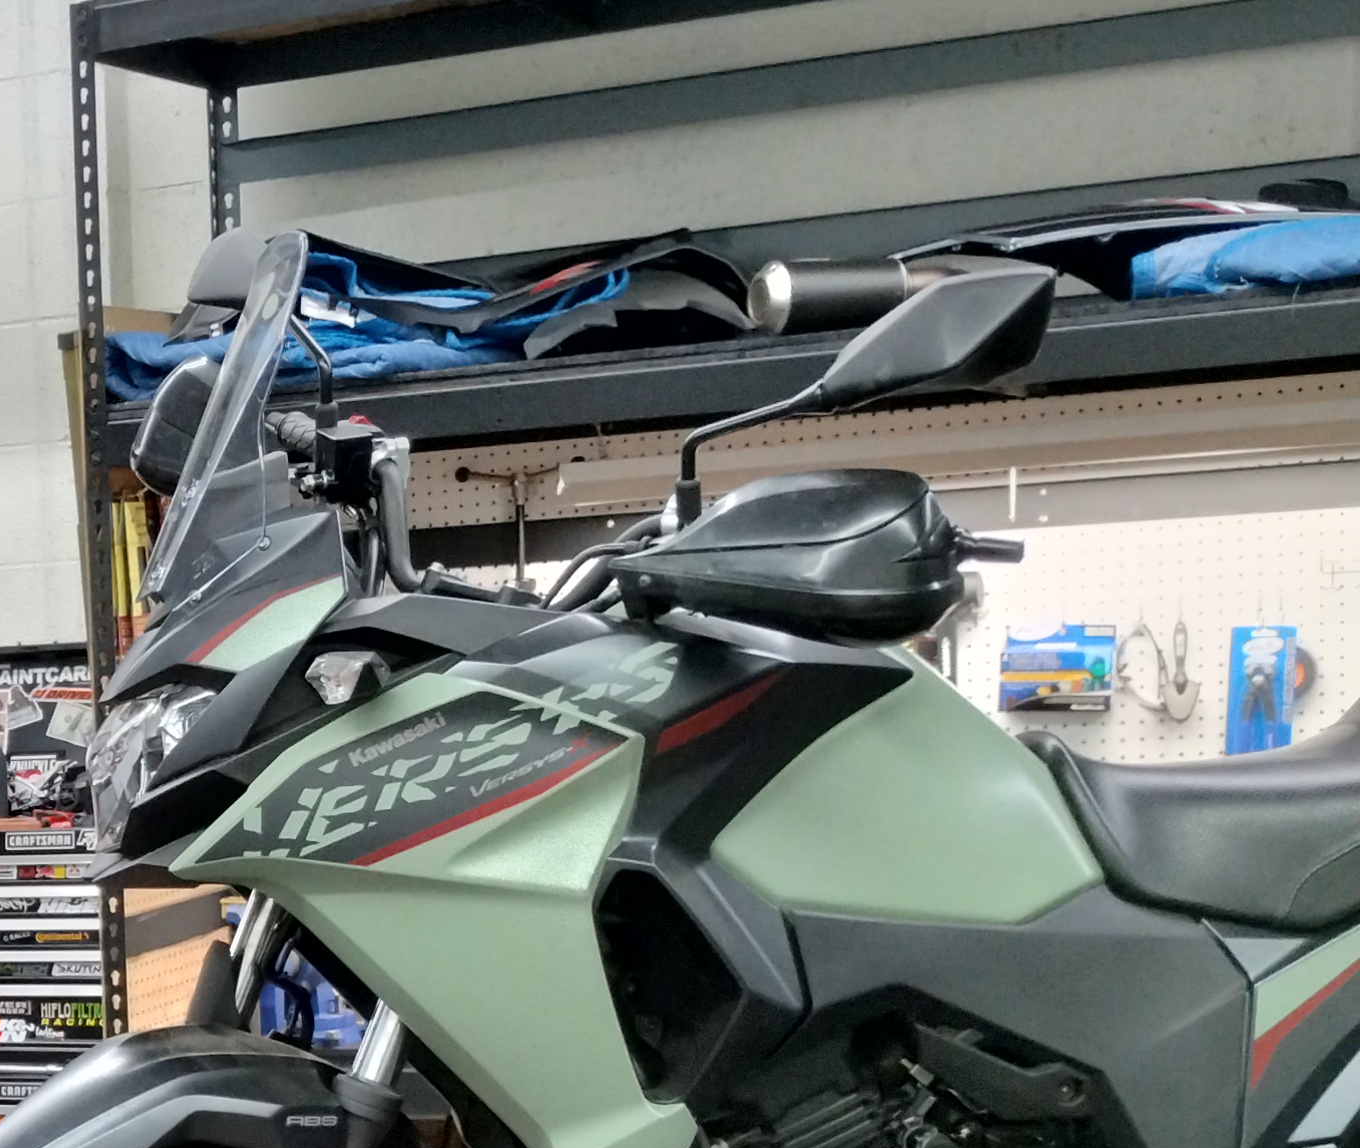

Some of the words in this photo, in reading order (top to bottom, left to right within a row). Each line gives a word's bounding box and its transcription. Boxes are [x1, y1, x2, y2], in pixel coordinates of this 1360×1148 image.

[348, 713, 446, 767] Kawasaki
[9, 835, 71, 846] CRAFTSMAN
[286, 1115, 338, 1126] ABS
